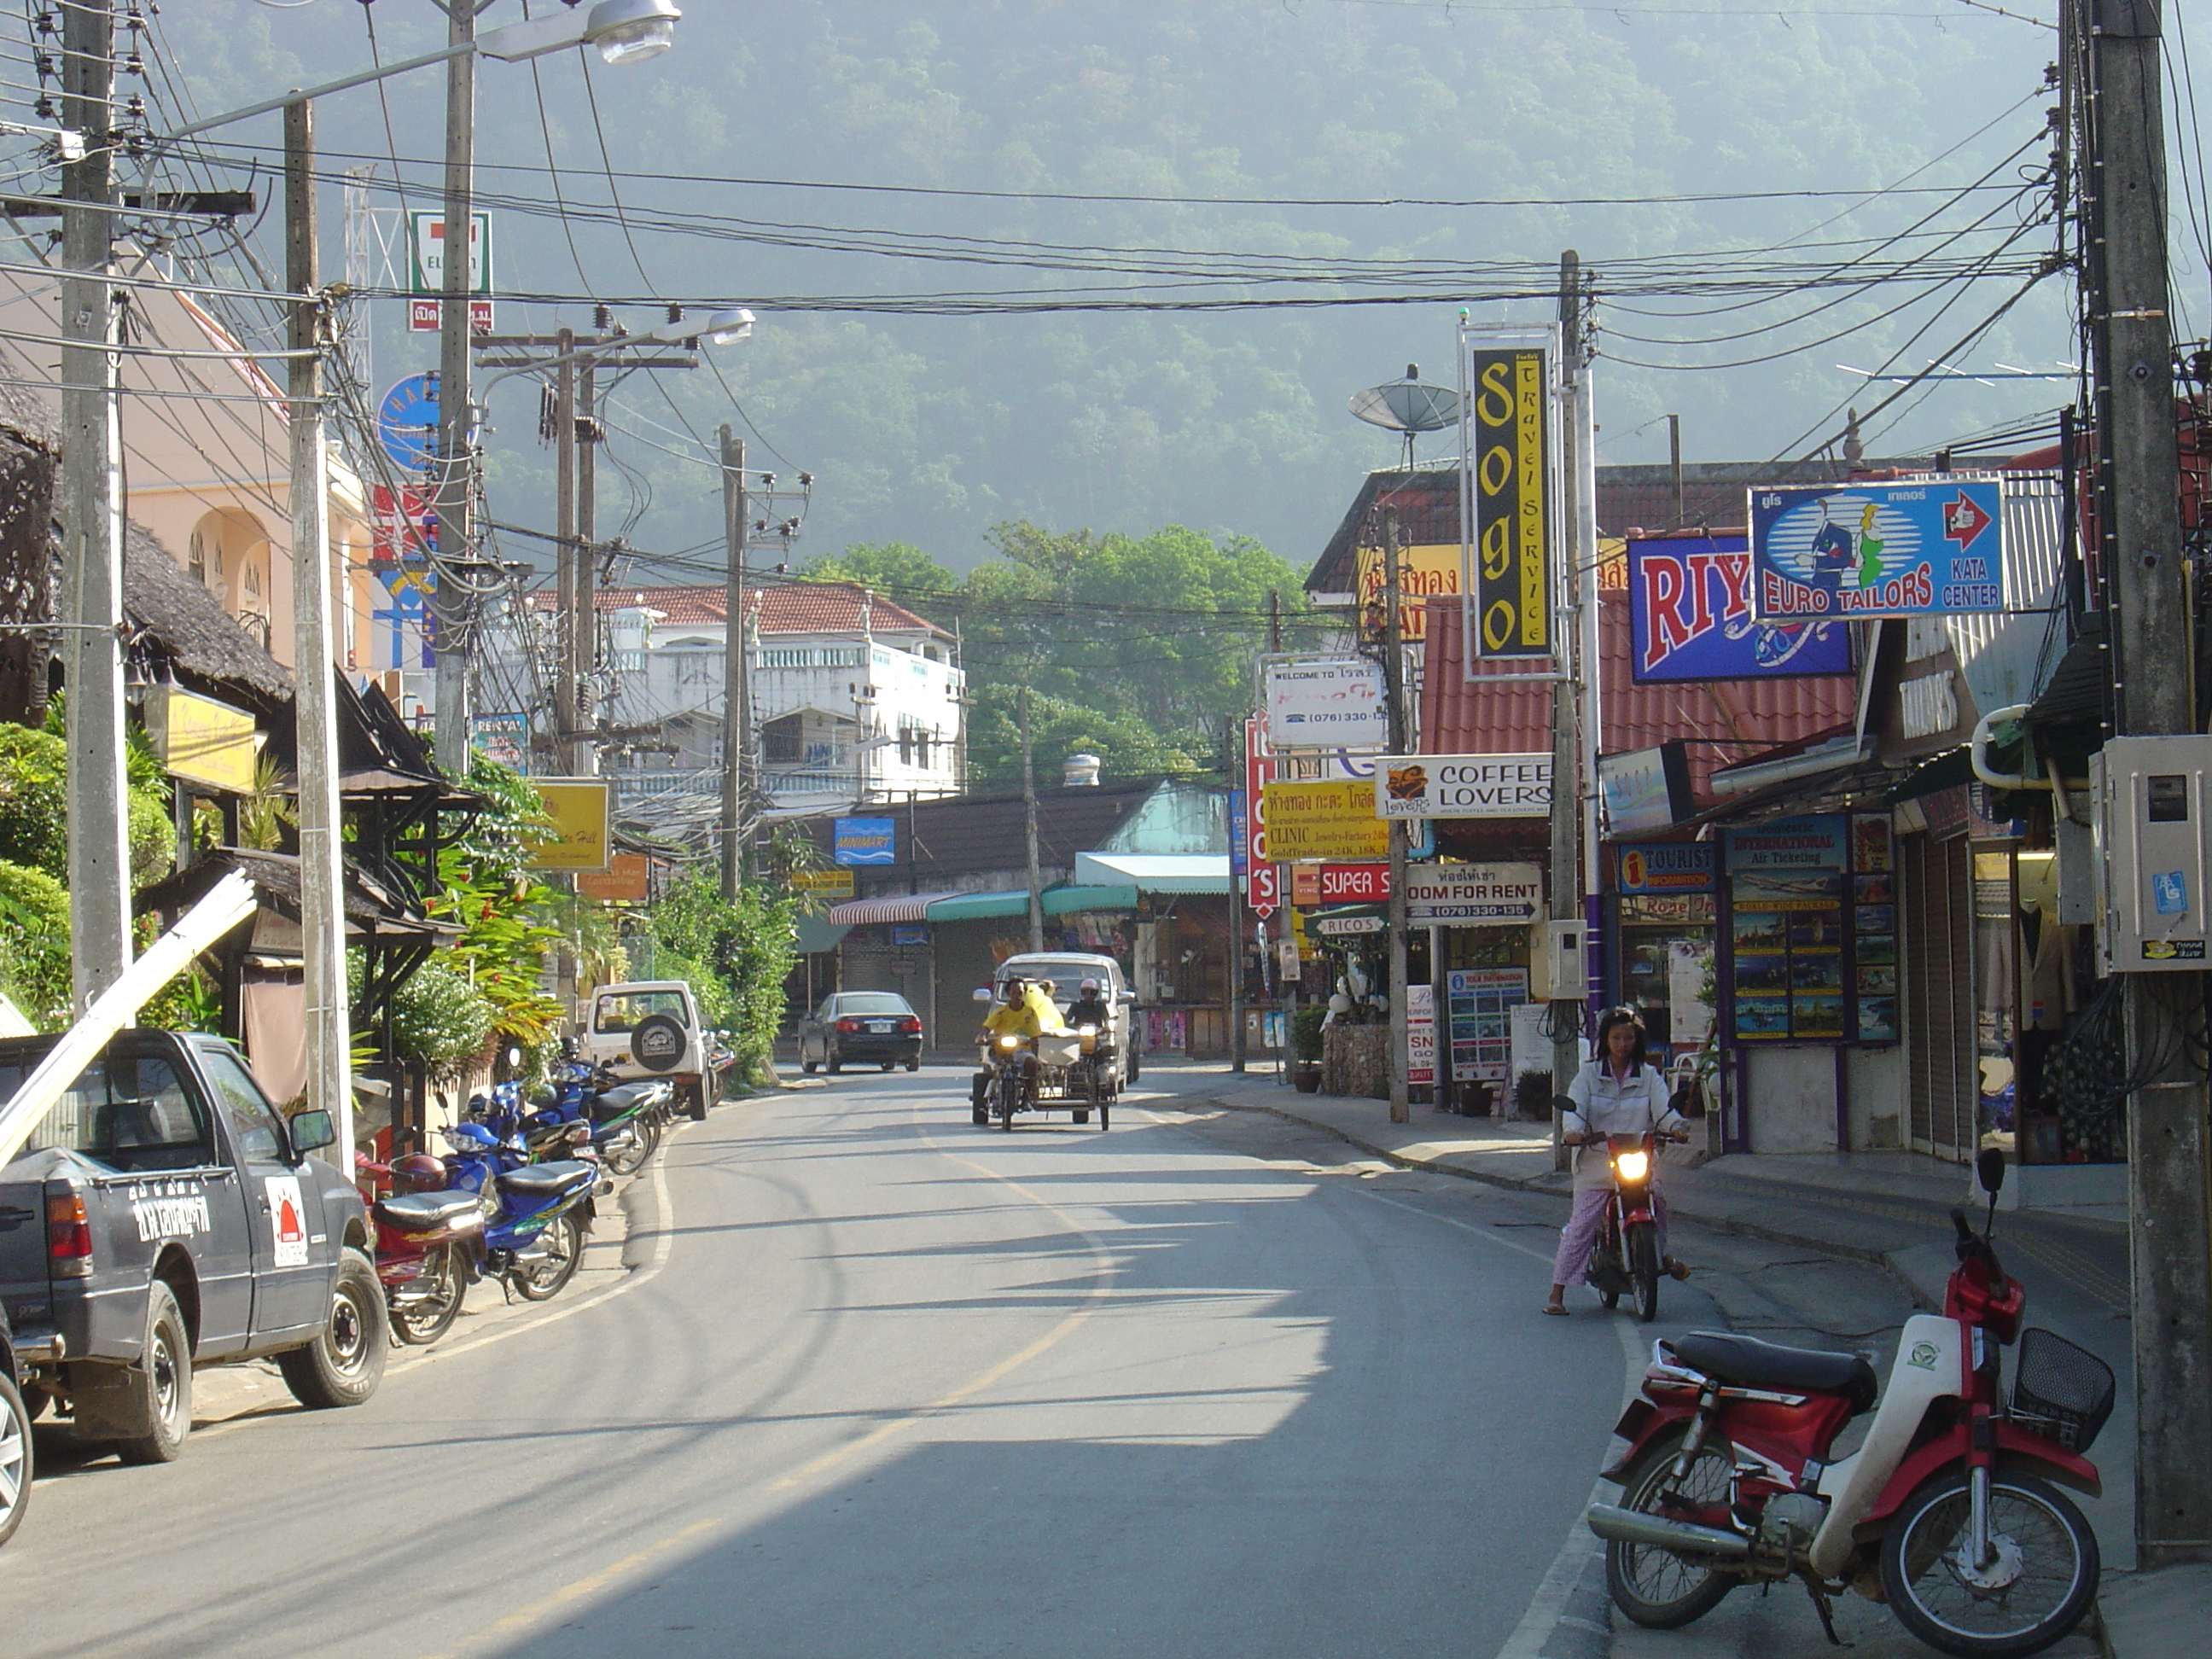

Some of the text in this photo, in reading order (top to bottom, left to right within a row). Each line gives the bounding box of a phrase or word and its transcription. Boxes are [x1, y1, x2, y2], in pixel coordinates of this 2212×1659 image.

[428, 256, 476, 270] ELn
[1952, 558, 1988, 580] KATA
[1763, 562, 1934, 614] EURO TAILORS
[1943, 585, 2000, 608] CENTER
[1275, 672, 1319, 680] WELCOME
[1439, 765, 1551, 784] COFFEE
[1269, 790, 1312, 812] ห้างทอง
[1440, 786, 1551, 806] LOVERS
[836, 836, 892, 849] MINIMART
[1270, 828, 1310, 844] CLINIC
[1644, 847, 1712, 870] TOURIST
[1752, 852, 1821, 864] Air Ticketing
[1323, 871, 1390, 894] SUPER S
[1408, 883, 1538, 899] OOM FOR RENT
[1328, 918, 1373, 932] RICO'S
